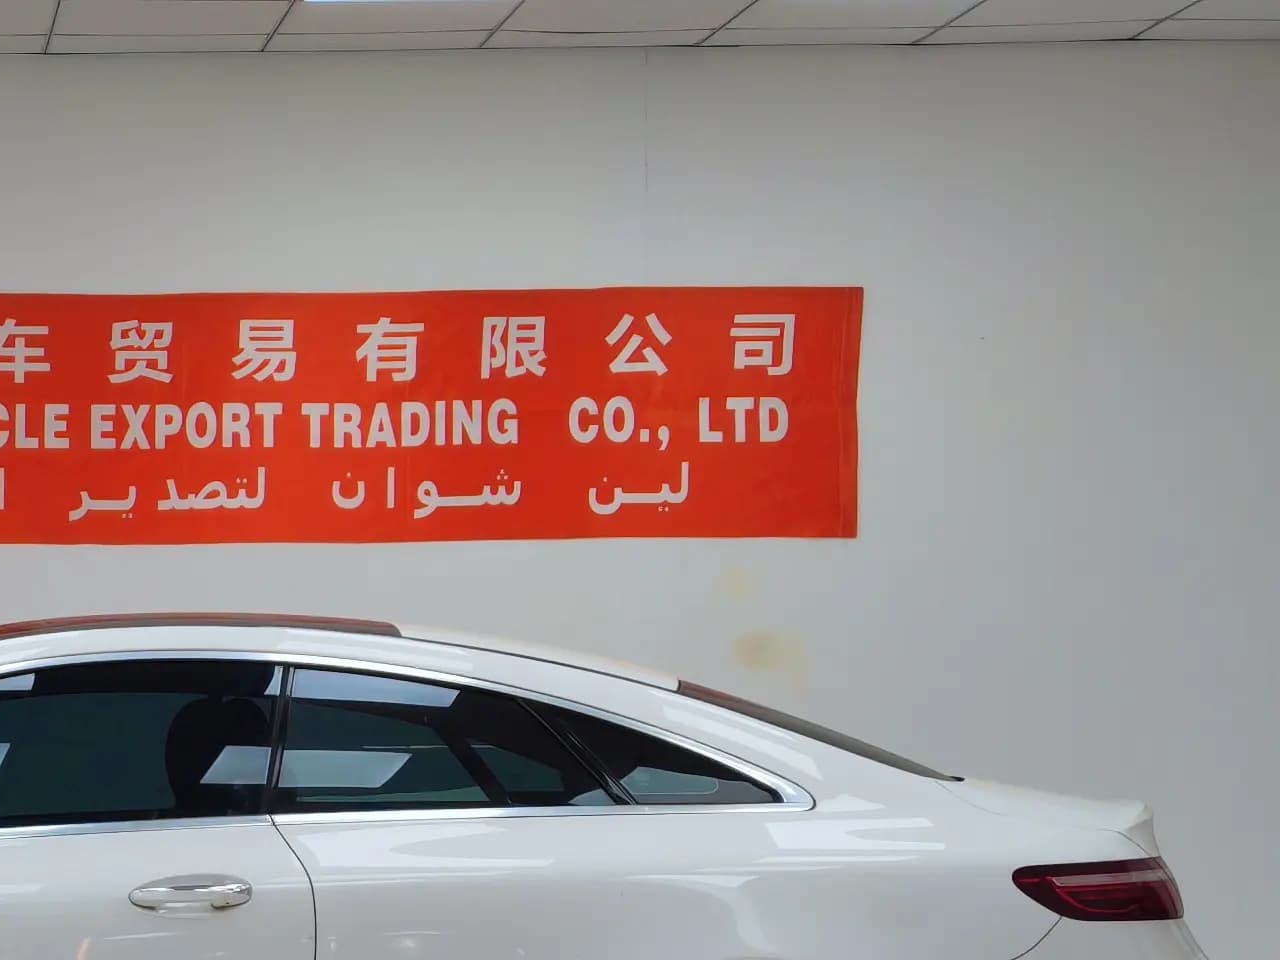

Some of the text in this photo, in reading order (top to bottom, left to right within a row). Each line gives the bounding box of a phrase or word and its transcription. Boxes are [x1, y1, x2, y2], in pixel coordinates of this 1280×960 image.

[90, 401, 283, 450] EXPORT
[301, 398, 518, 449] TRADING
[568, 395, 670, 451] CO.,
[698, 396, 789, 443] LTD
[332, 466, 521, 519] شوان
[588, 461, 689, 515] لين
